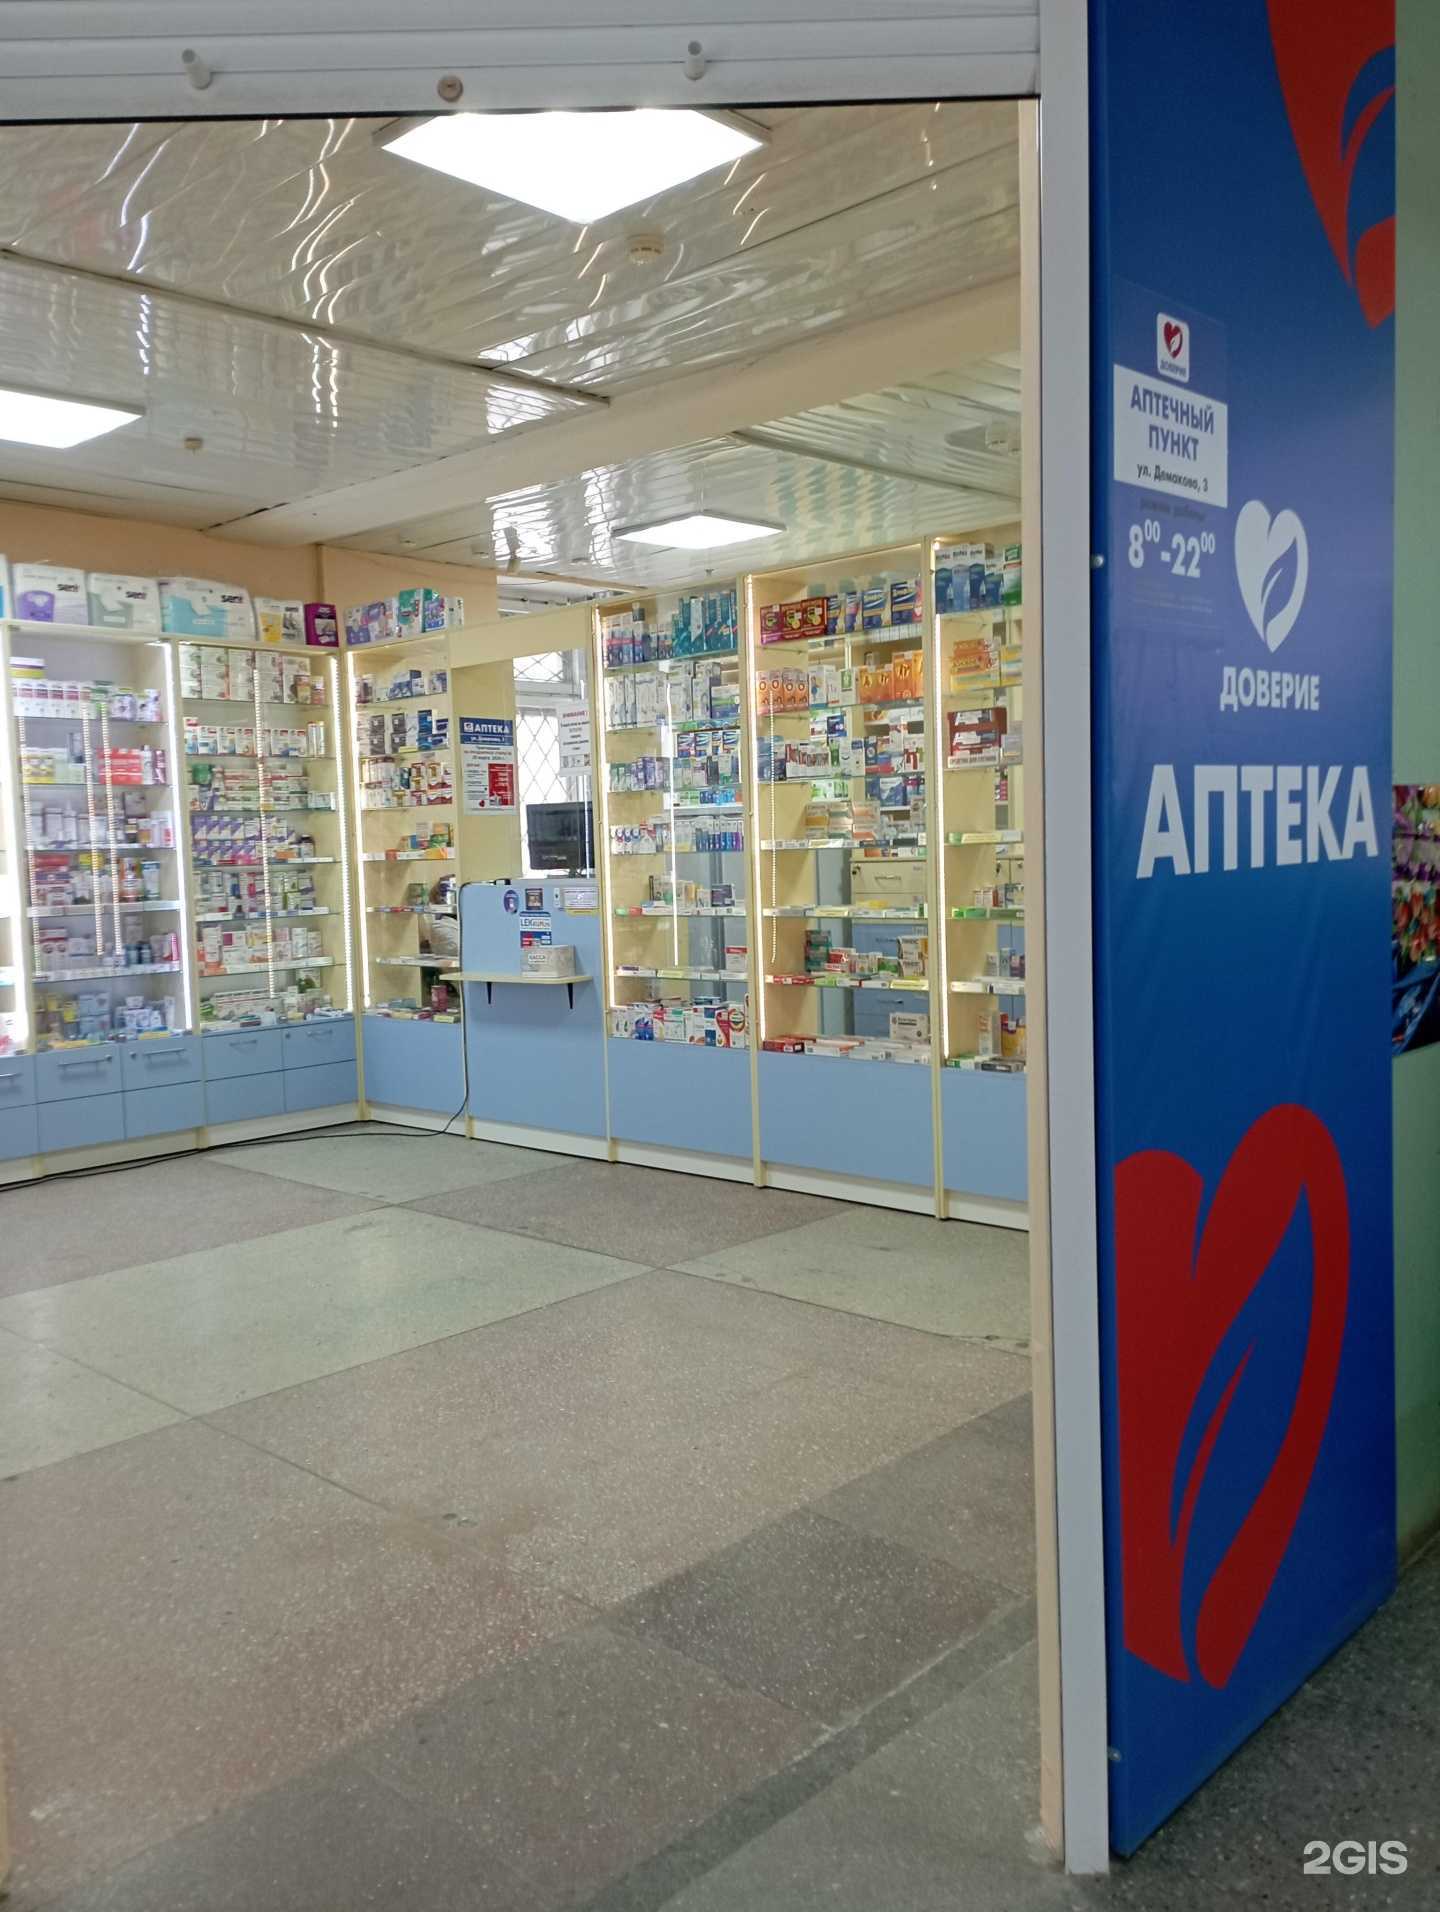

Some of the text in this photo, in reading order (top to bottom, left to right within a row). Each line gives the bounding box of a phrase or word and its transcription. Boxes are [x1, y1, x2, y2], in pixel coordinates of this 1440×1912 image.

[1130, 384, 1215, 435] АПТЕЧНЫЙ
[1148, 424, 1200, 462] ПУНКТ
[1136, 463, 1151, 478] ул.
[1202, 477, 1209, 492] 3
[1219, 666, 1321, 713] ДОВЕРИЕ
[474, 723, 510, 734] АПТЕКА
[1136, 764, 1380, 880] АПТЕКА
